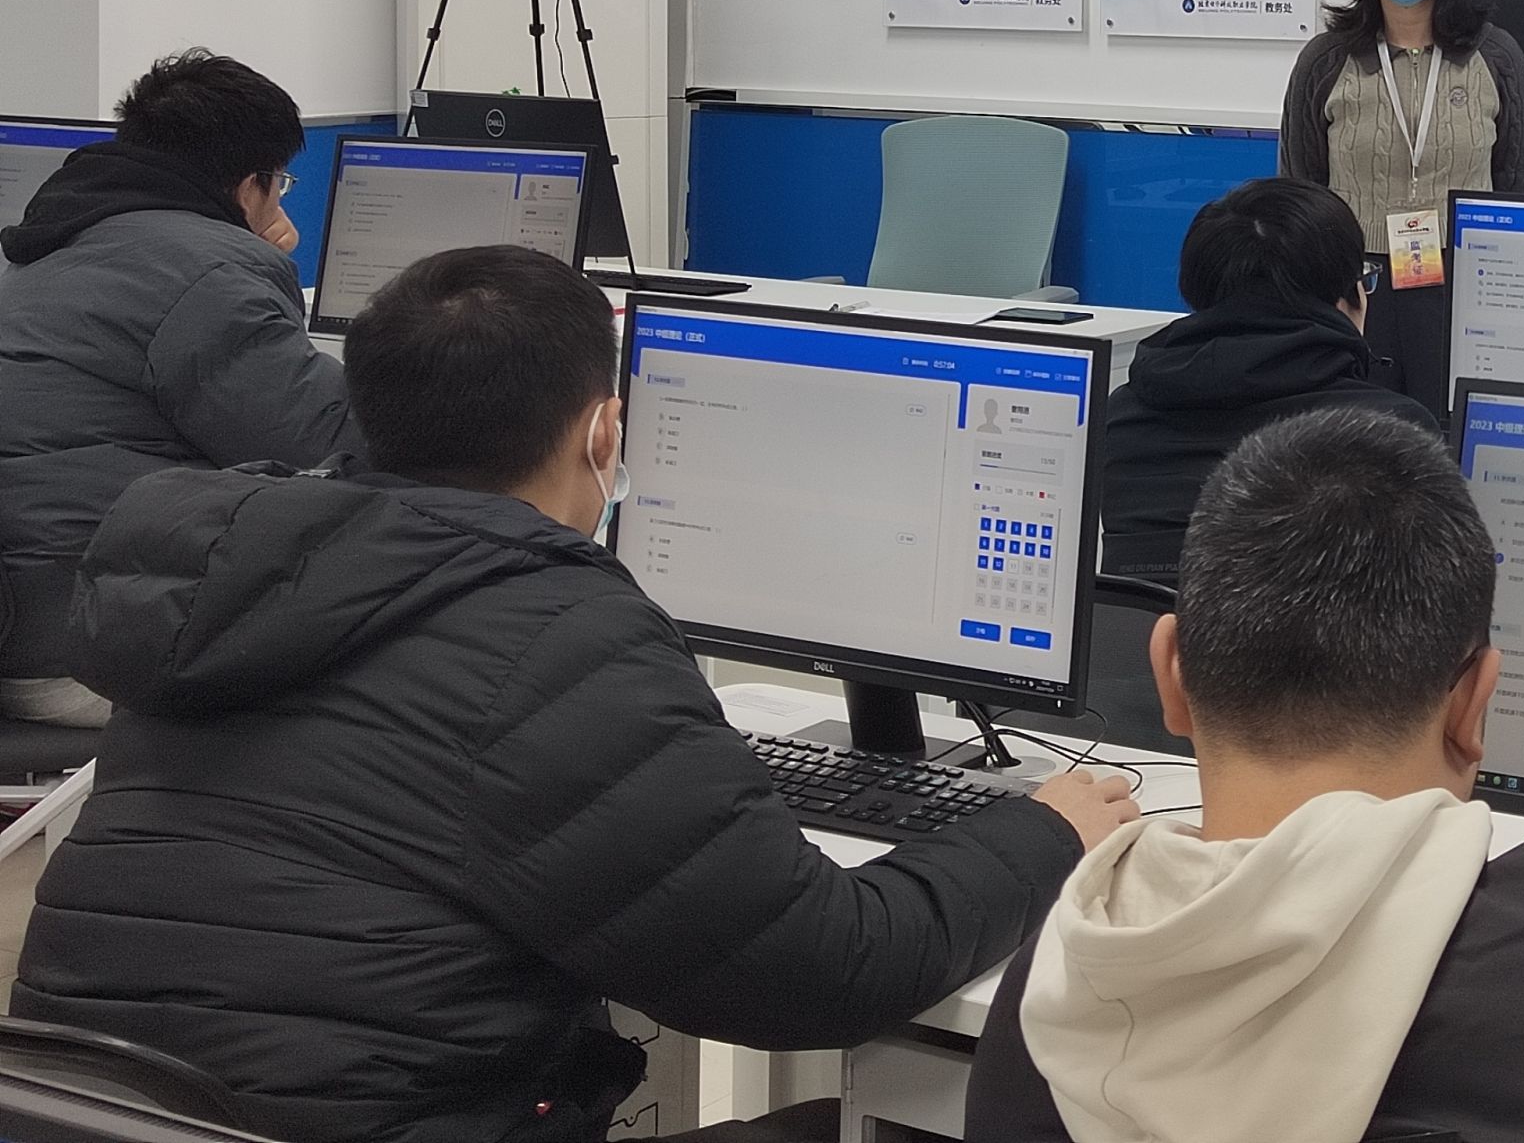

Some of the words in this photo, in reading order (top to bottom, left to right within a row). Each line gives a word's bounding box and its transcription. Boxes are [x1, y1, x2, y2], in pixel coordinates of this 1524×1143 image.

[1265, 2, 1293, 14] 教务处
[637, 327, 653, 336] 2023
[1470, 419, 1492, 431] 2023
[814, 661, 835, 673] DELL
